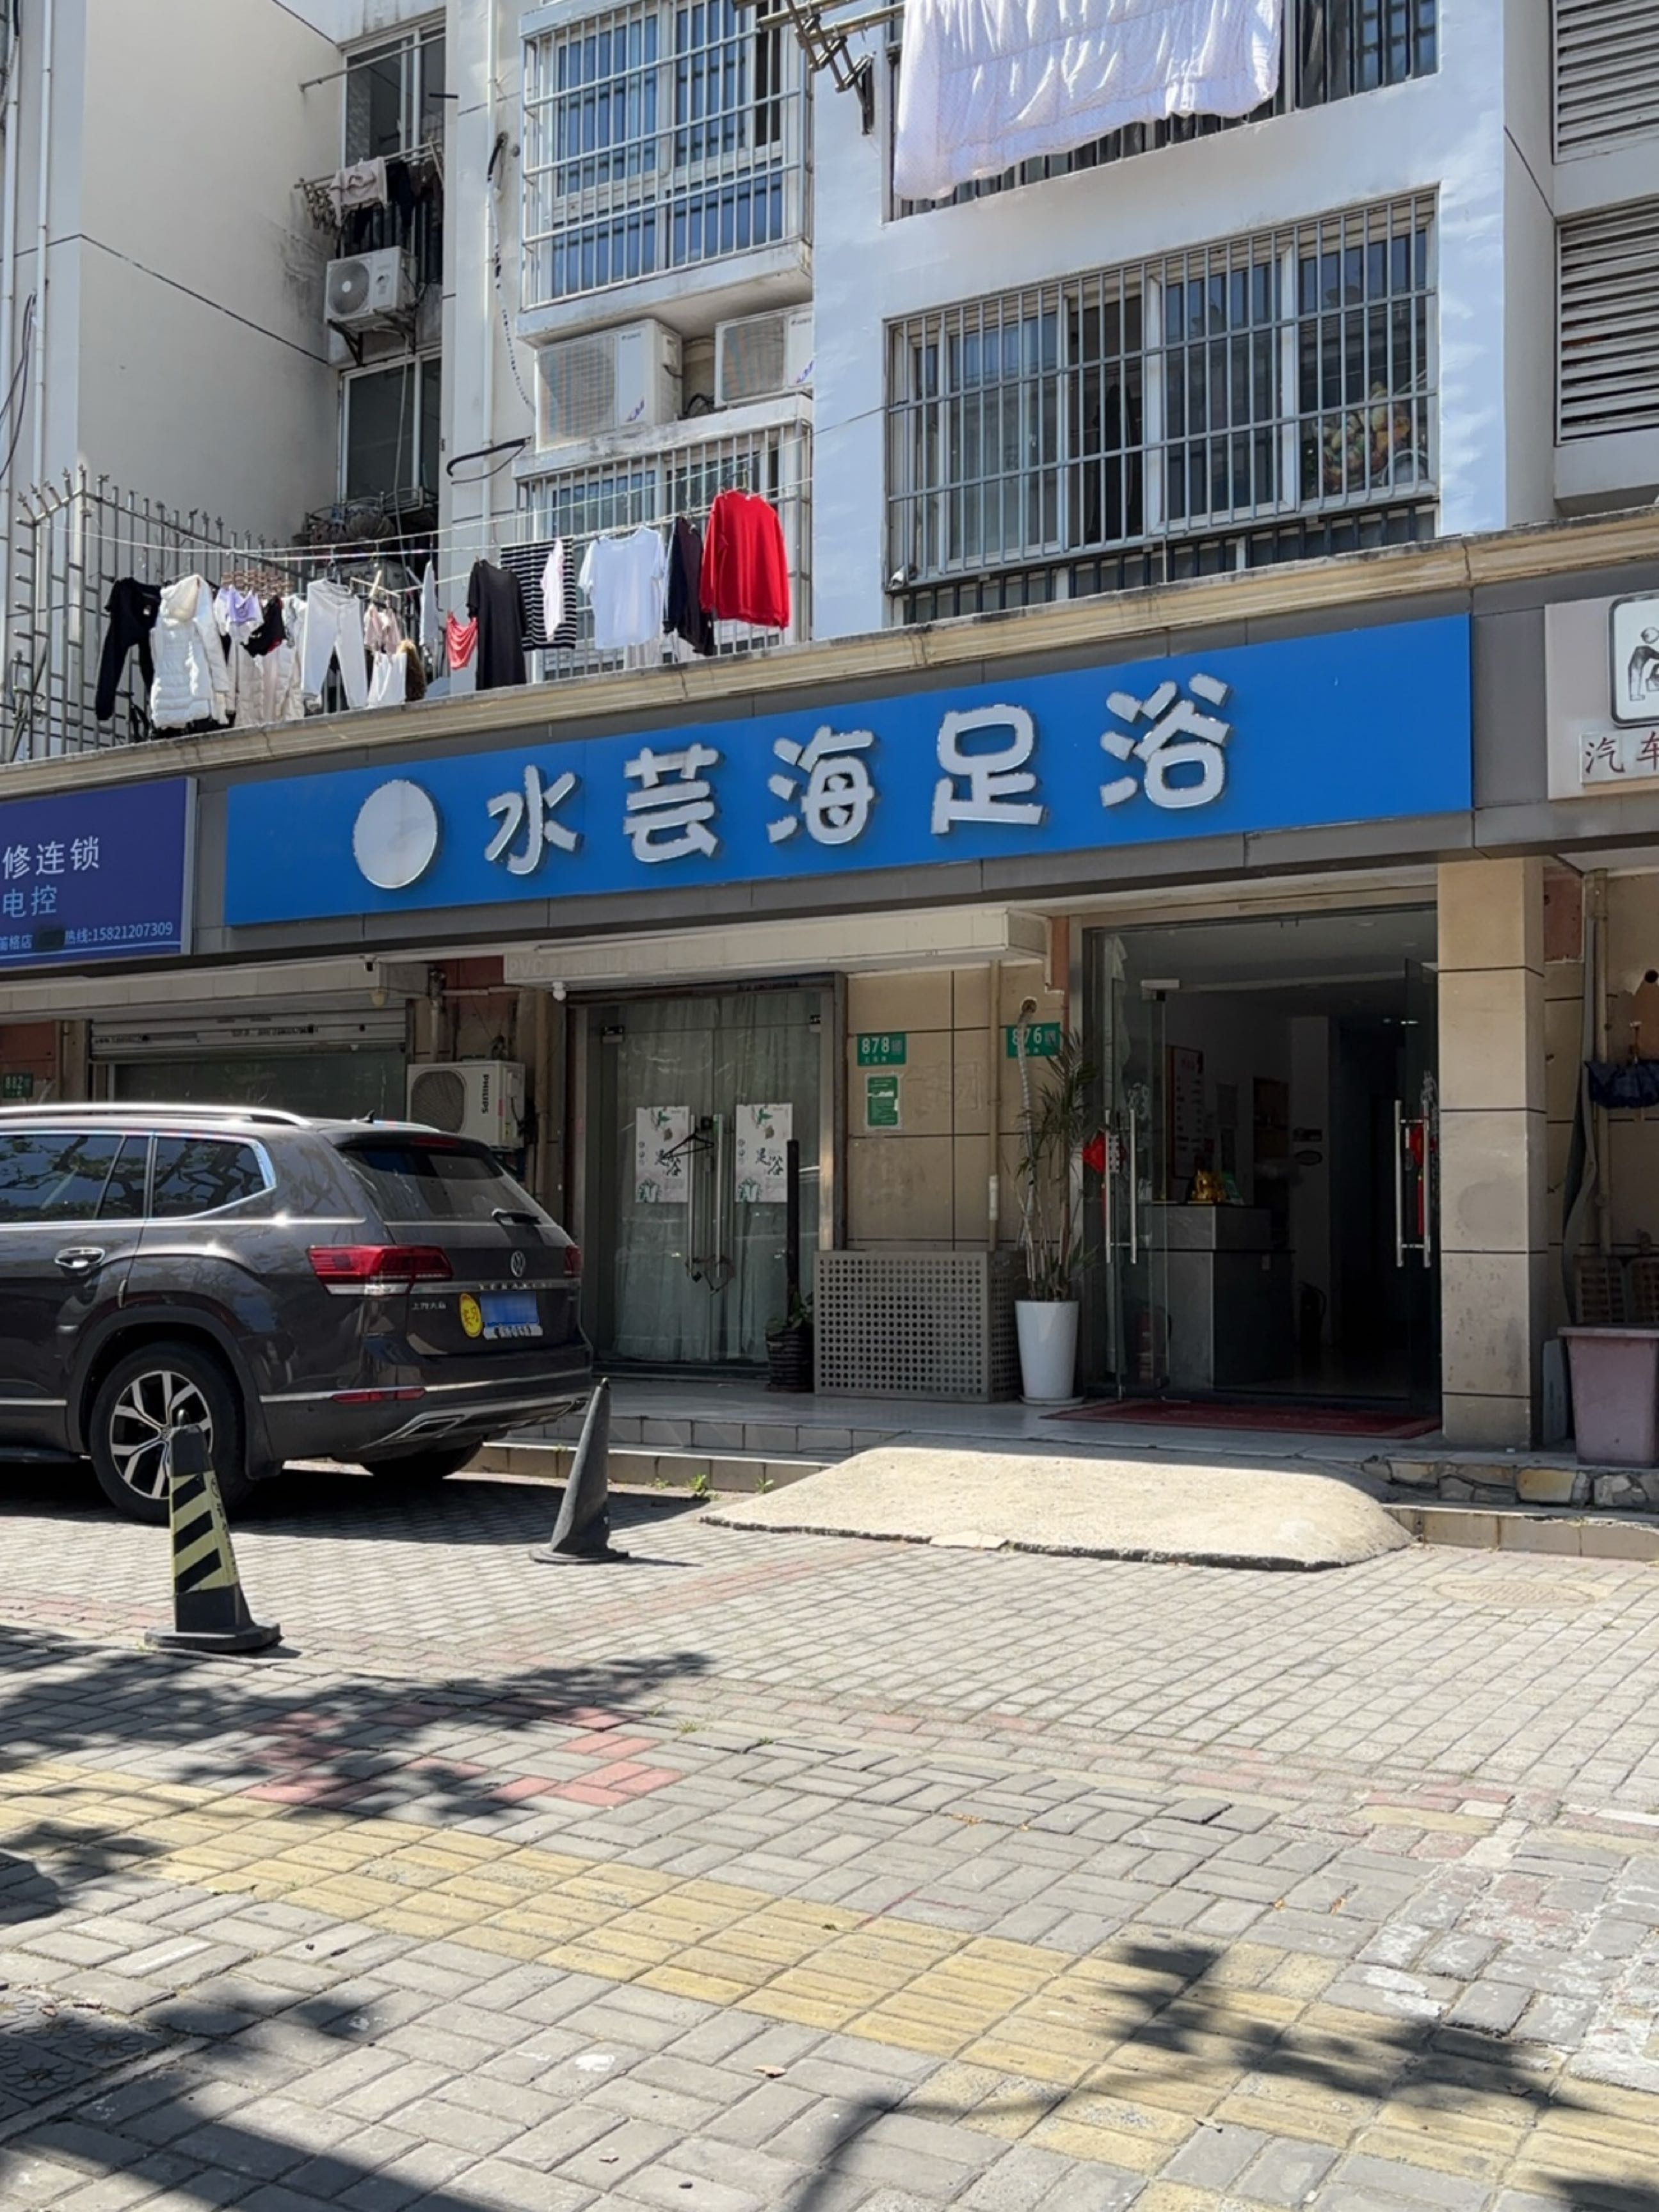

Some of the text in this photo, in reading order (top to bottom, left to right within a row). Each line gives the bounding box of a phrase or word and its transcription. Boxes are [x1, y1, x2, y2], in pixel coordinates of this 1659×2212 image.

[483, 672, 1231, 875] 水芸海足浴
[2, 835, 100, 880] 修连锁
[2, 885, 58, 918] 电控
[862, 1036, 890, 1054] 878
